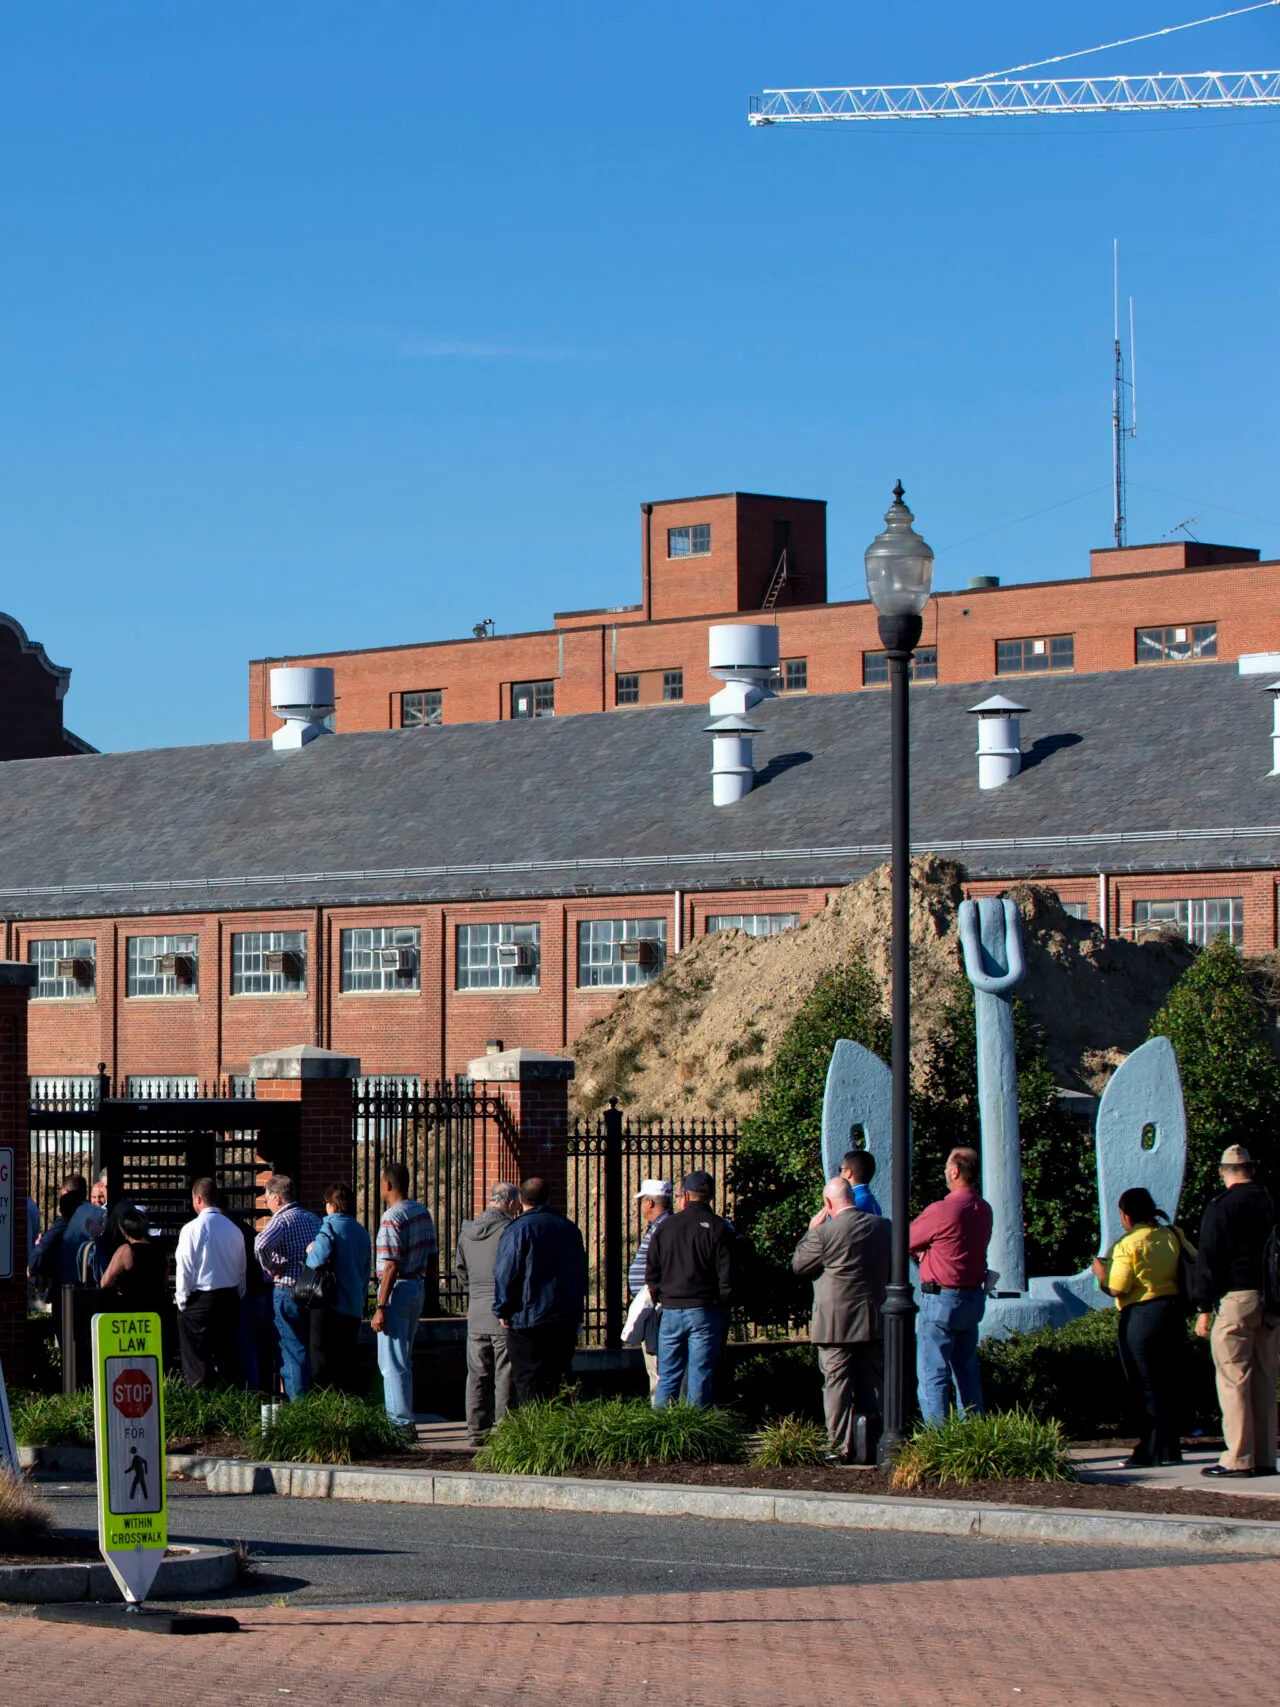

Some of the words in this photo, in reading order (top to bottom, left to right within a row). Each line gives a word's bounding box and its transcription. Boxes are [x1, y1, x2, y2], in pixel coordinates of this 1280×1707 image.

[111, 1319, 151, 1334] STATE
[118, 1337, 145, 1352] LAW
[115, 1384, 151, 1403] STOP
[124, 1427, 144, 1439] FOR
[123, 1518, 152, 1529] WITHIN
[112, 1531, 161, 1545] CROSSWALK
